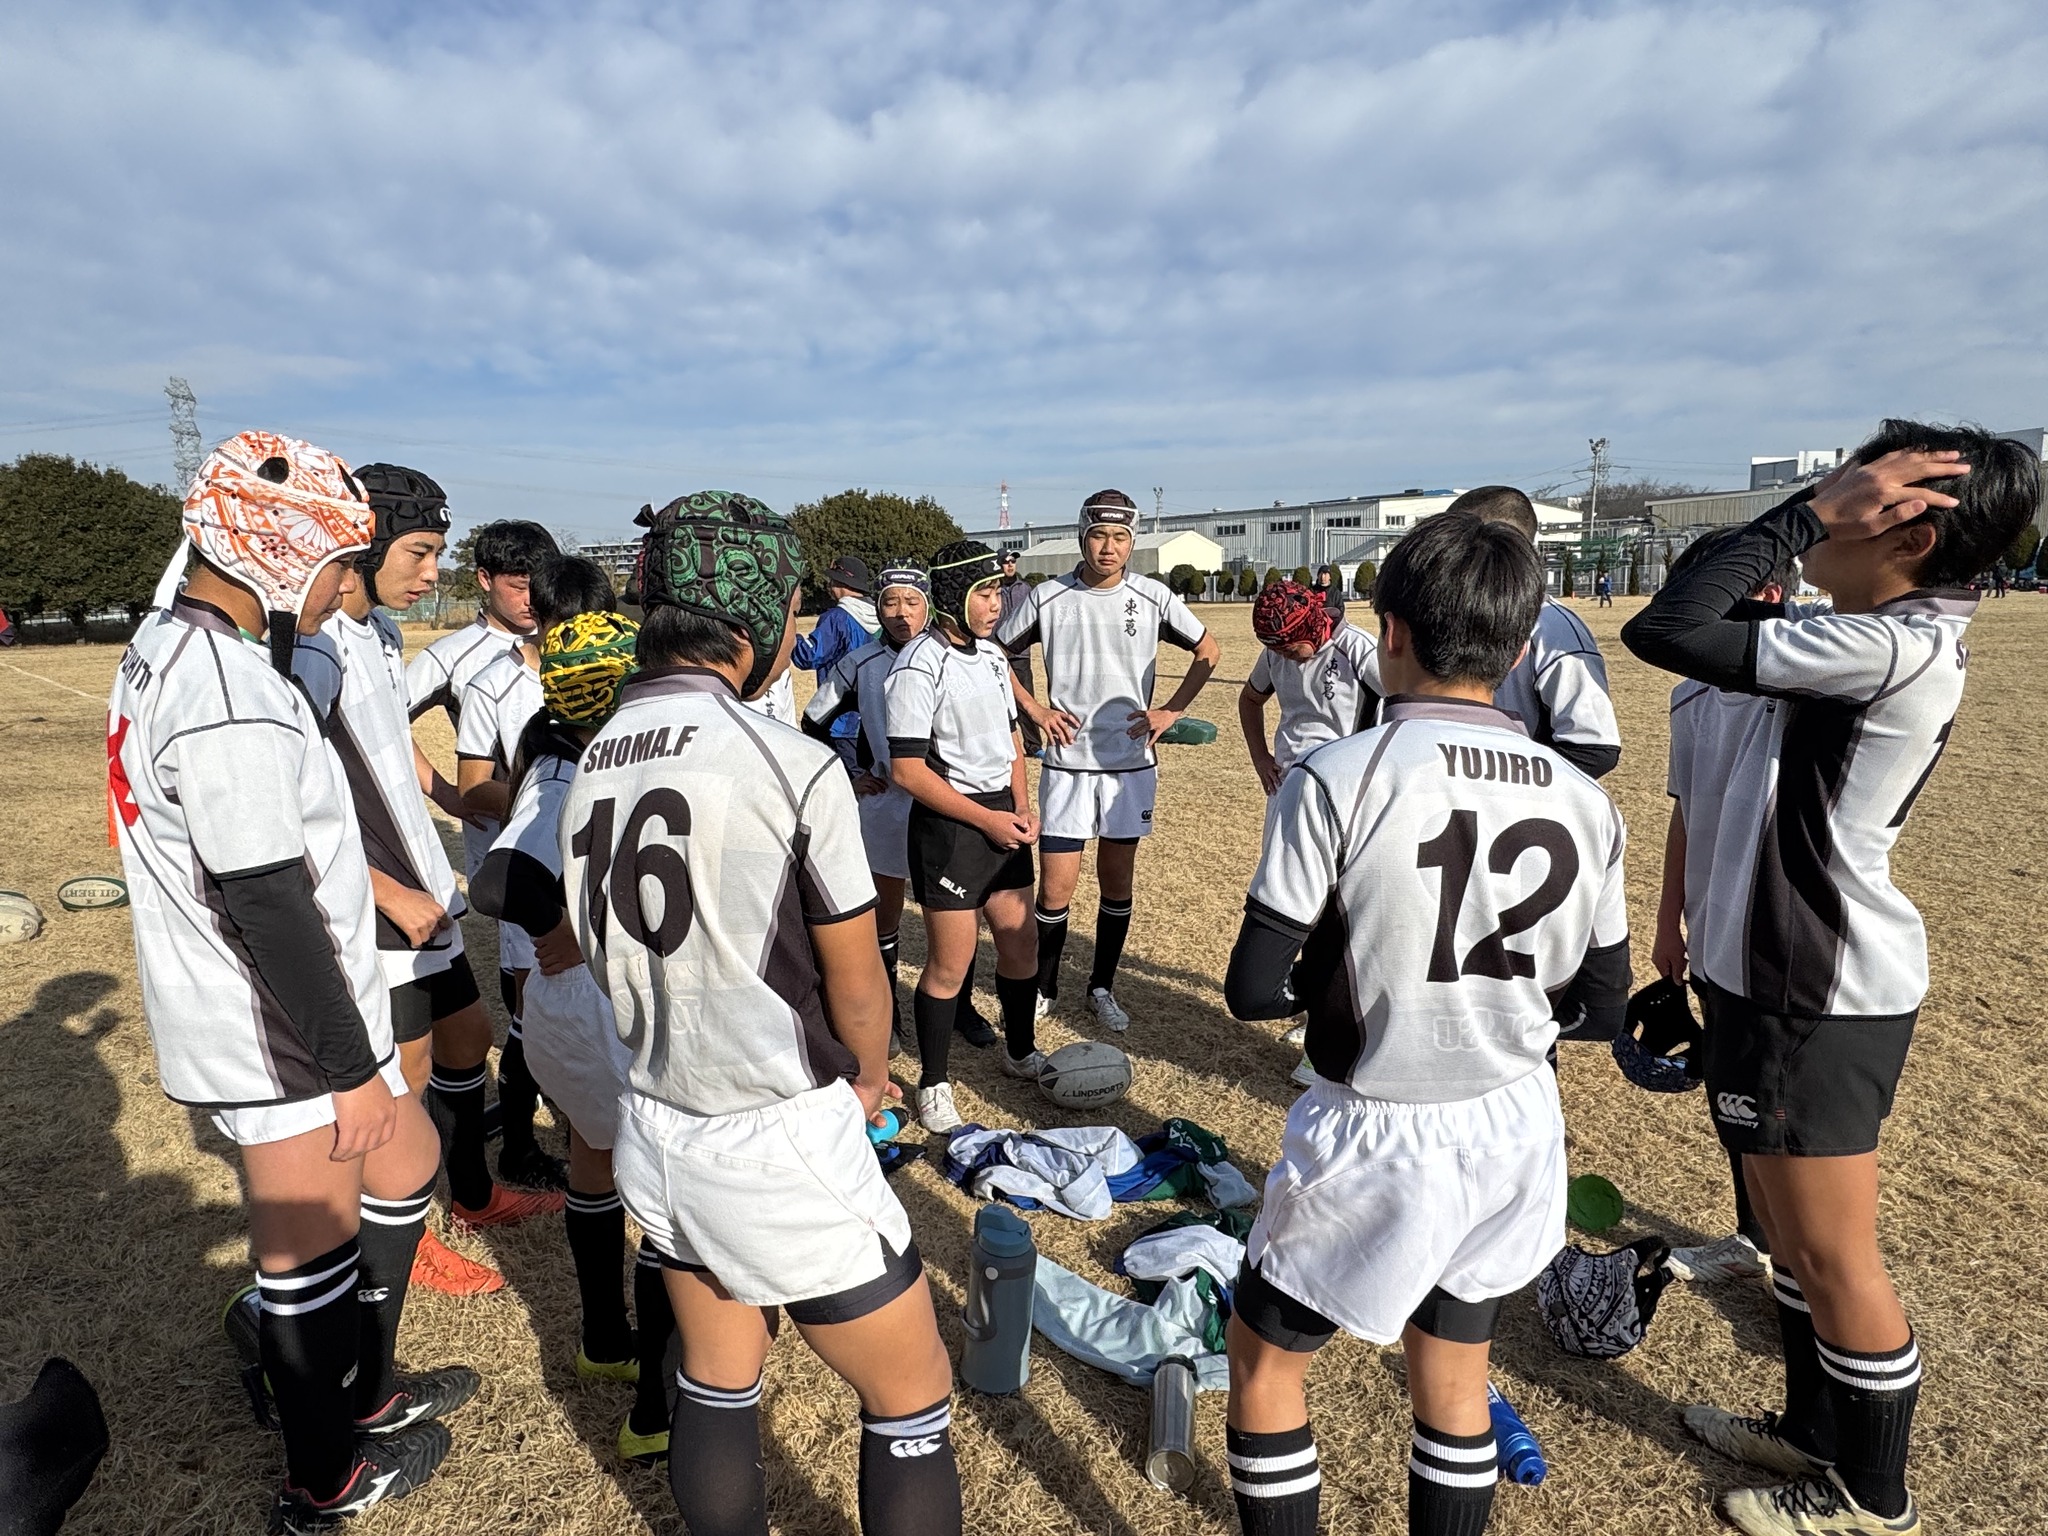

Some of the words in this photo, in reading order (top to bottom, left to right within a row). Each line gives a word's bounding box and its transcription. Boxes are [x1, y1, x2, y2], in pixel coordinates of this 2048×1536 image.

[584, 726, 699, 773] SHOMA.F
[1437, 743, 1552, 787] YUJIRO
[572, 787, 693, 962] 16
[939, 876, 967, 899] BLK
[1418, 809, 1579, 983] 12
[1072, 1081, 1124, 1098] LINDSPORTS
